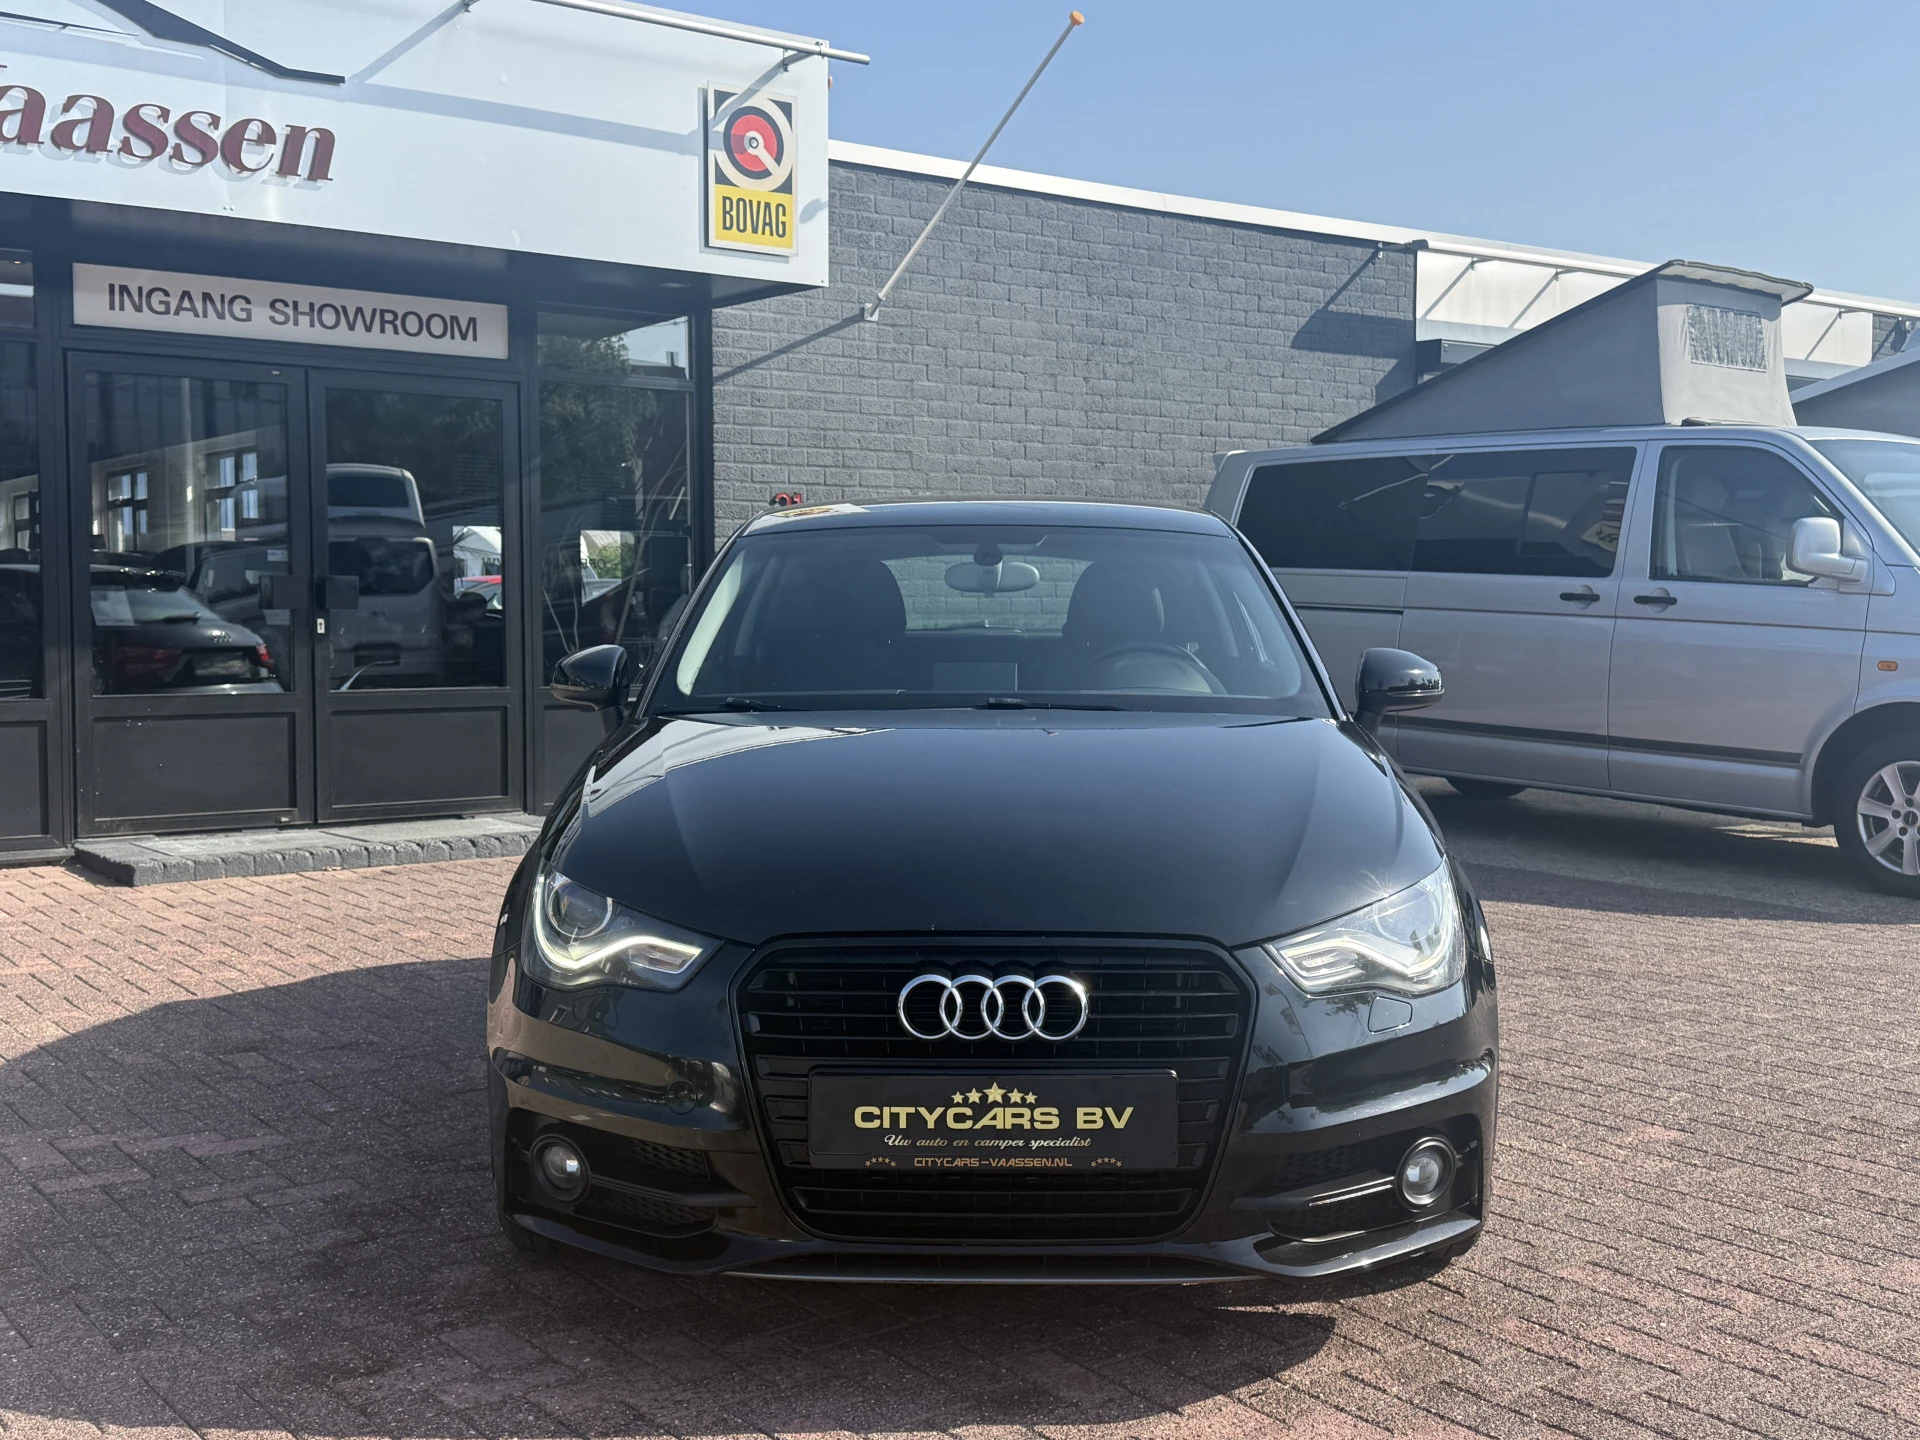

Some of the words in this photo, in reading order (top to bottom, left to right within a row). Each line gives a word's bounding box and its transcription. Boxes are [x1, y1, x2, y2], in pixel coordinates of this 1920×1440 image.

[0, 65, 336, 181] aassen
[722, 196, 786, 238] BOVAG
[107, 283, 253, 322] INGANG
[268, 298, 478, 342] SHOWROOM
[854, 1106, 1060, 1130] CITYCARS
[1075, 1106, 1134, 1129] BV
[883, 1134, 912, 1147] Uw
[916, 1137, 948, 1147] auto
[952, 1139, 970, 1147] en
[973, 1137, 1026, 1149] camper
[1028, 1136, 1092, 1150] specialist
[913, 1157, 1073, 1168] CITYCARS-VAASSEN.NL
